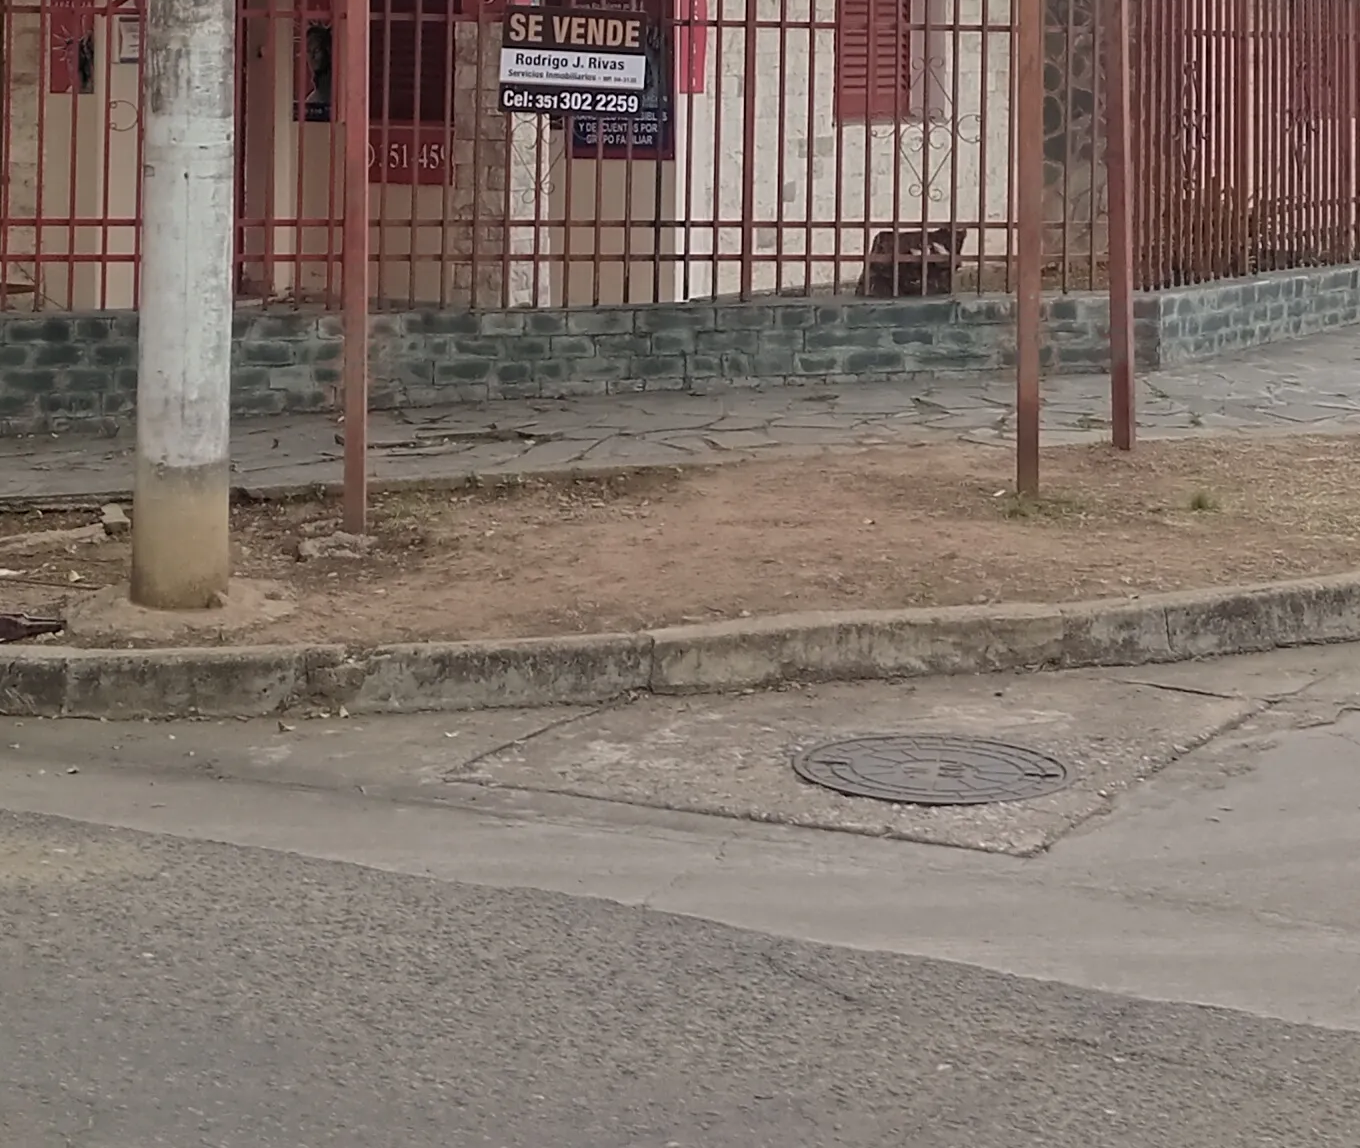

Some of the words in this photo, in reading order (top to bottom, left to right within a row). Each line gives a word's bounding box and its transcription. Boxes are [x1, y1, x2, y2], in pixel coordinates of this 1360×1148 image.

[509, 13, 544, 42] SE
[552, 15, 641, 48] VENDE
[515, 53, 569, 70] Rodrigo
[572, 56, 585, 69] J.
[588, 57, 625, 71] Rivas
[503, 90, 533, 107] Cel:
[535, 95, 557, 107] 351
[560, 92, 593, 111] 302
[595, 94, 639, 113] 2259
[585, 123, 639, 133] DECUENTS
[586, 134, 615, 144] GRPO
[615, 135, 653, 145] FAILIAR
[378, 143, 446, 170] 51-45
